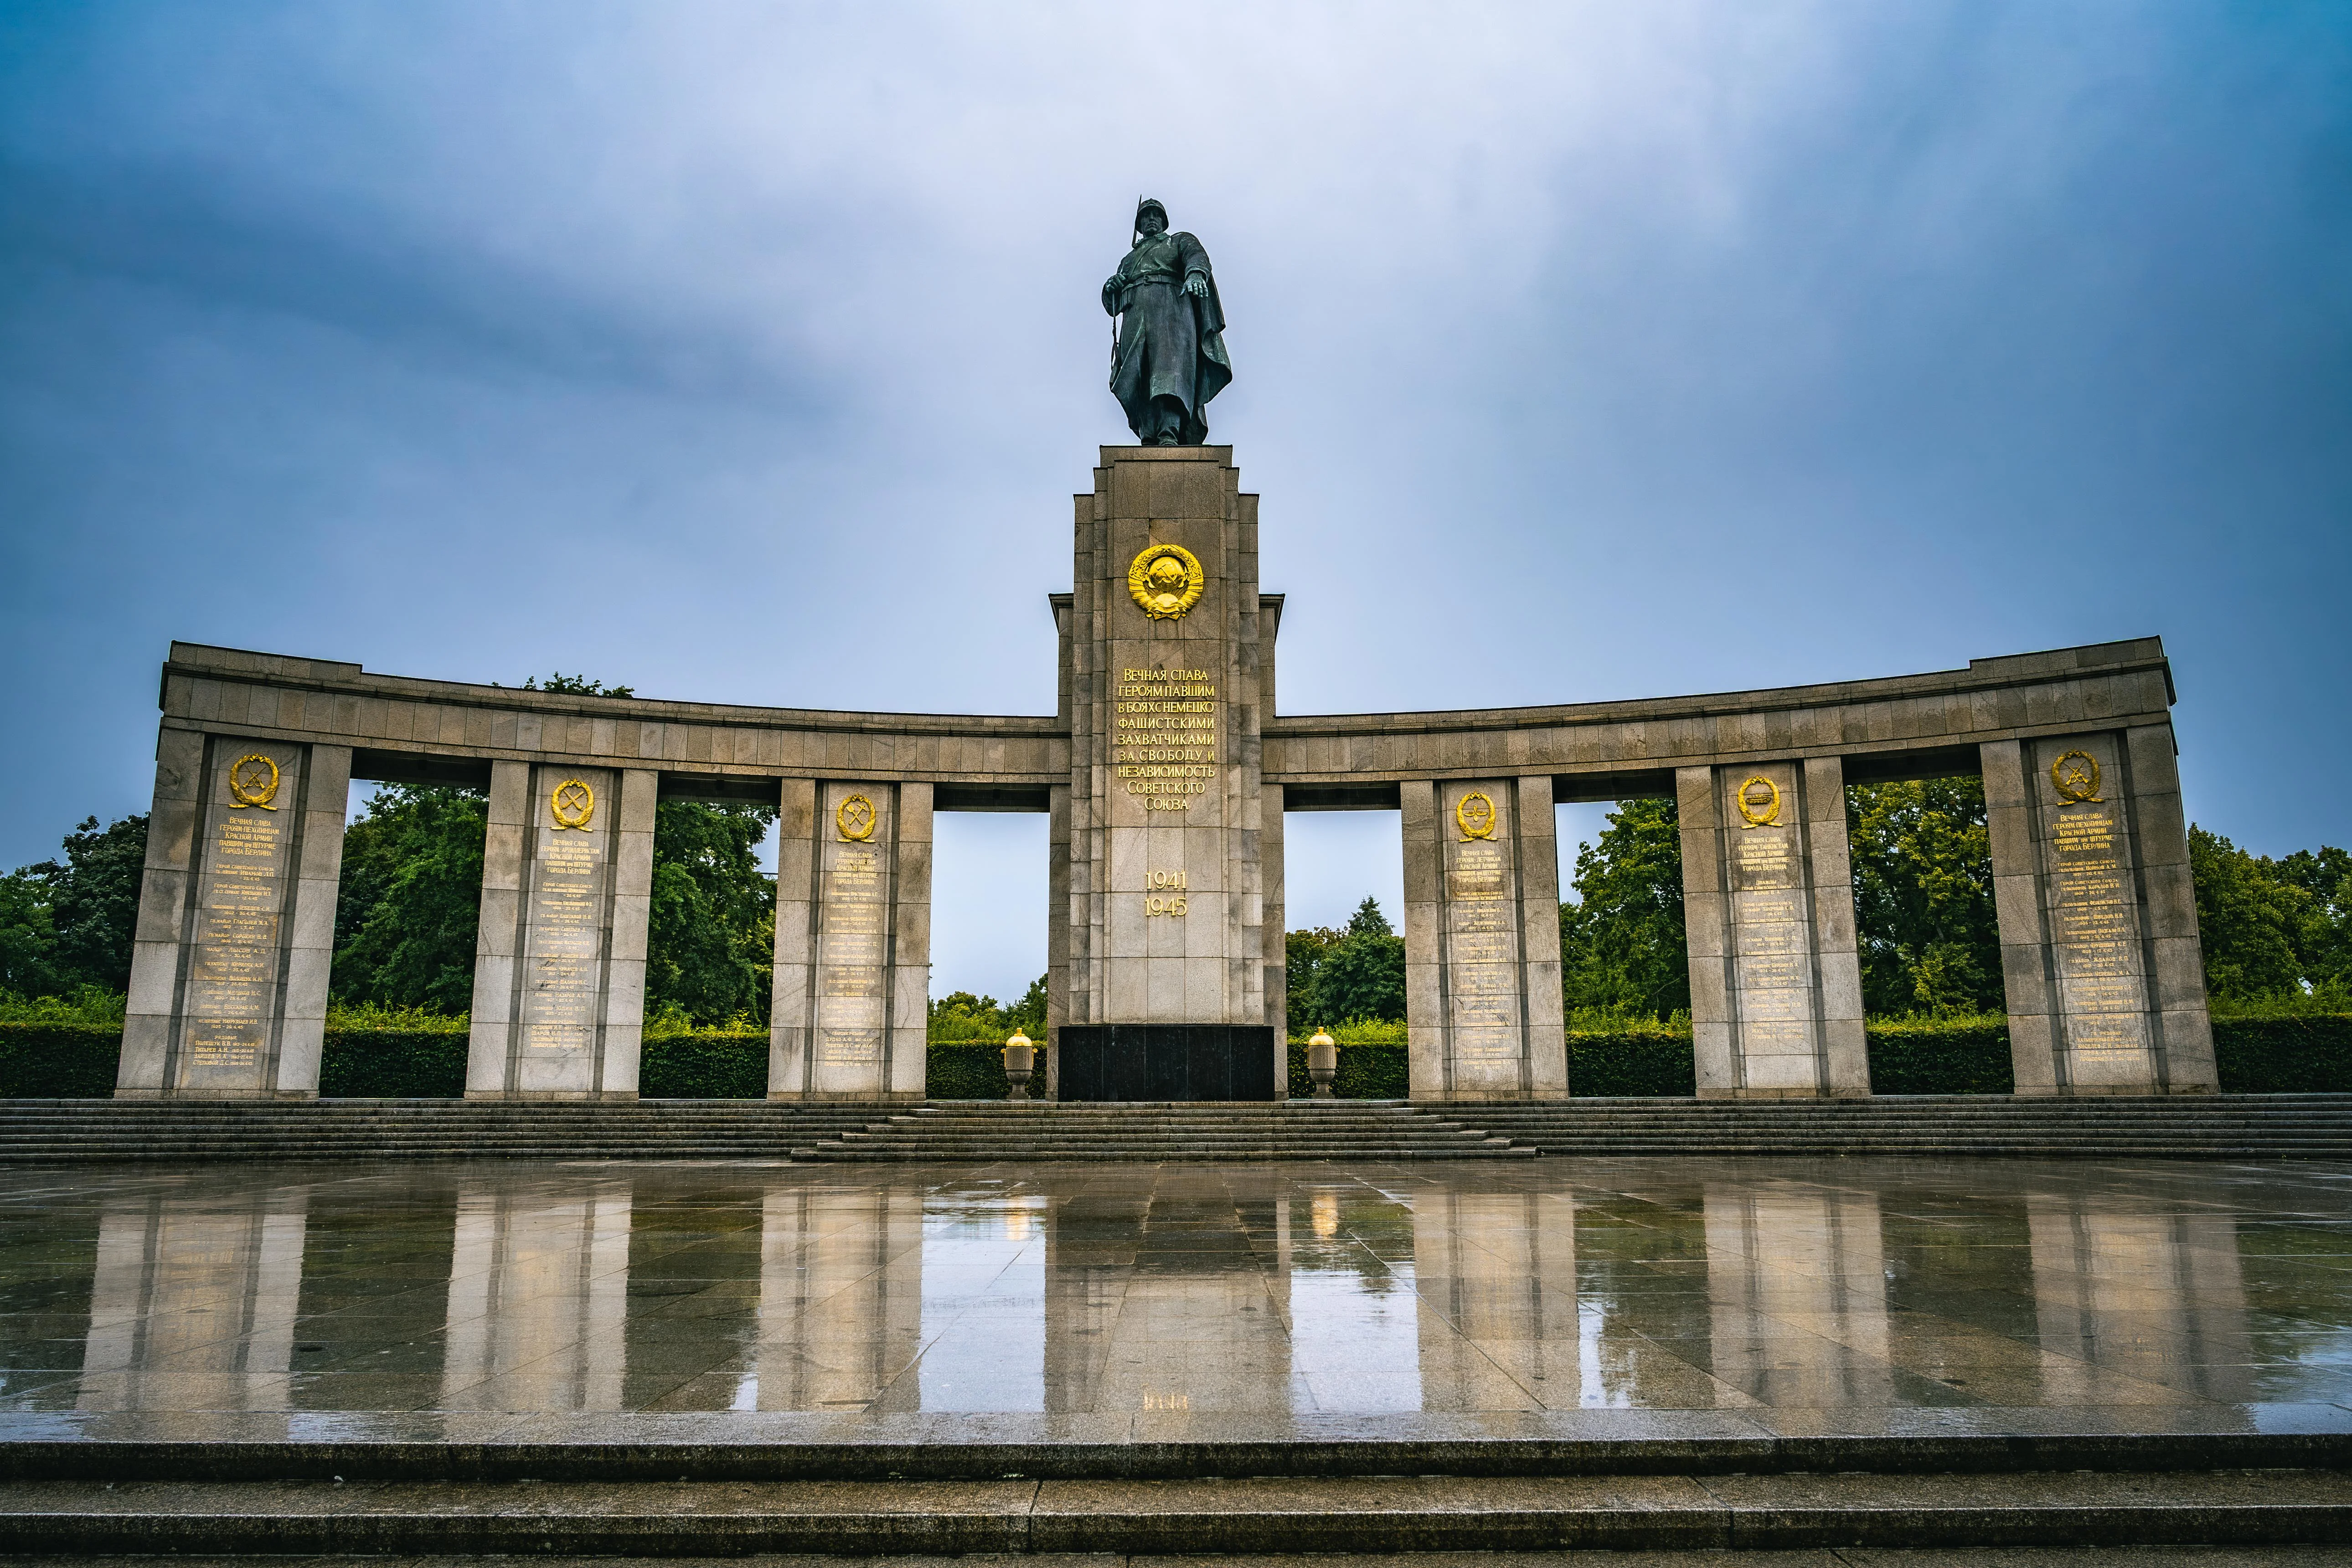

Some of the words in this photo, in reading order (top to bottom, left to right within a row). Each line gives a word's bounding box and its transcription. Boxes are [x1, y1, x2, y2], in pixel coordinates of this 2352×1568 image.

[1124, 669, 1167, 681] ВЕЧНАЯ
[1171, 670, 1208, 681] СЛАВА
[1119, 686, 1162, 697] ГЕРОЯМ
[1164, 686, 1214, 696] ПАВШИМ
[1118, 703, 1124, 713] В
[1126, 702, 1155, 713] БОЯХ
[1155, 703, 1161, 712] С
[1163, 702, 1214, 713] НЕМЕЦКО
[1118, 718, 1214, 729] ФАШИСТСКИМИ
[1118, 734, 1214, 746] ЗАХВАТЧИКАМИ
[1119, 751, 1135, 761] ЗА
[1140, 750, 1203, 761] СВОБОДУ
[1208, 751, 1214, 761] И
[1118, 766, 1215, 778] НЕЗАВИСИМОСТЬ
[1127, 780, 1205, 794] СОВЕТСКОГО
[1144, 797, 1189, 810] СОЮЗА
[229, 816, 252, 825] ВЕЧНАЯ
[225, 831, 251, 840] КРАСНОЙ
[2059, 828, 2085, 836] КРАСНОЙ
[2083, 841, 2110, 850] БЕРЛИНА
[245, 848, 272, 856] БЕРЛИНА
[1146, 871, 1186, 889] 1941
[1145, 897, 1187, 916] 1945
